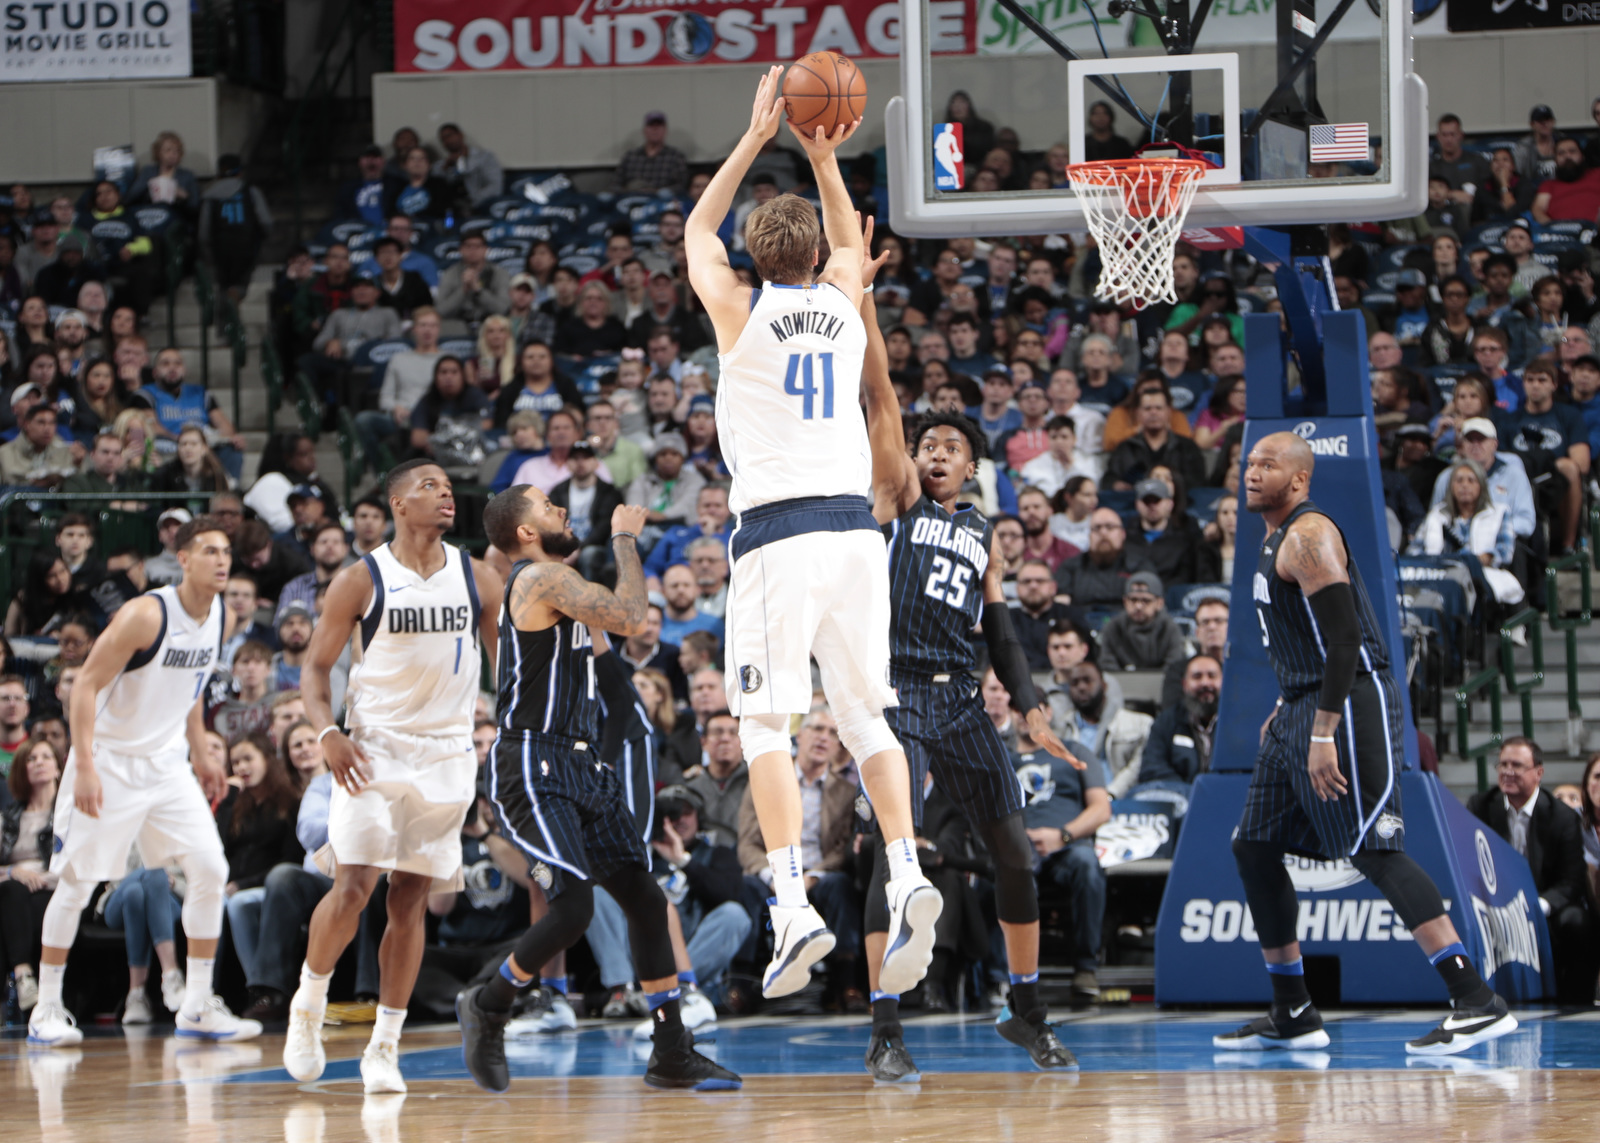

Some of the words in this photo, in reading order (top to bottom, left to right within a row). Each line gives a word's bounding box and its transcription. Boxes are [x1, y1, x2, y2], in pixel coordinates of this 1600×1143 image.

[5, 1, 169, 31] STUDIO
[983, 0, 1100, 48] Spri
[6, 33, 87, 52] MOVIE
[97, 31, 172, 50] GRILL
[412, 14, 663, 70] SOUND
[769, 311, 845, 343] NOWITZKI
[783, 352, 834, 420] 41
[1306, 434, 1349, 457] DING
[925, 554, 973, 608] 25
[388, 605, 469, 634] DALLAS
[162, 647, 214, 669] DALLAS
[453, 636, 463, 675] 1
[1282, 856, 1355, 871] PORTS
[1180, 898, 1452, 942] SOHWES
